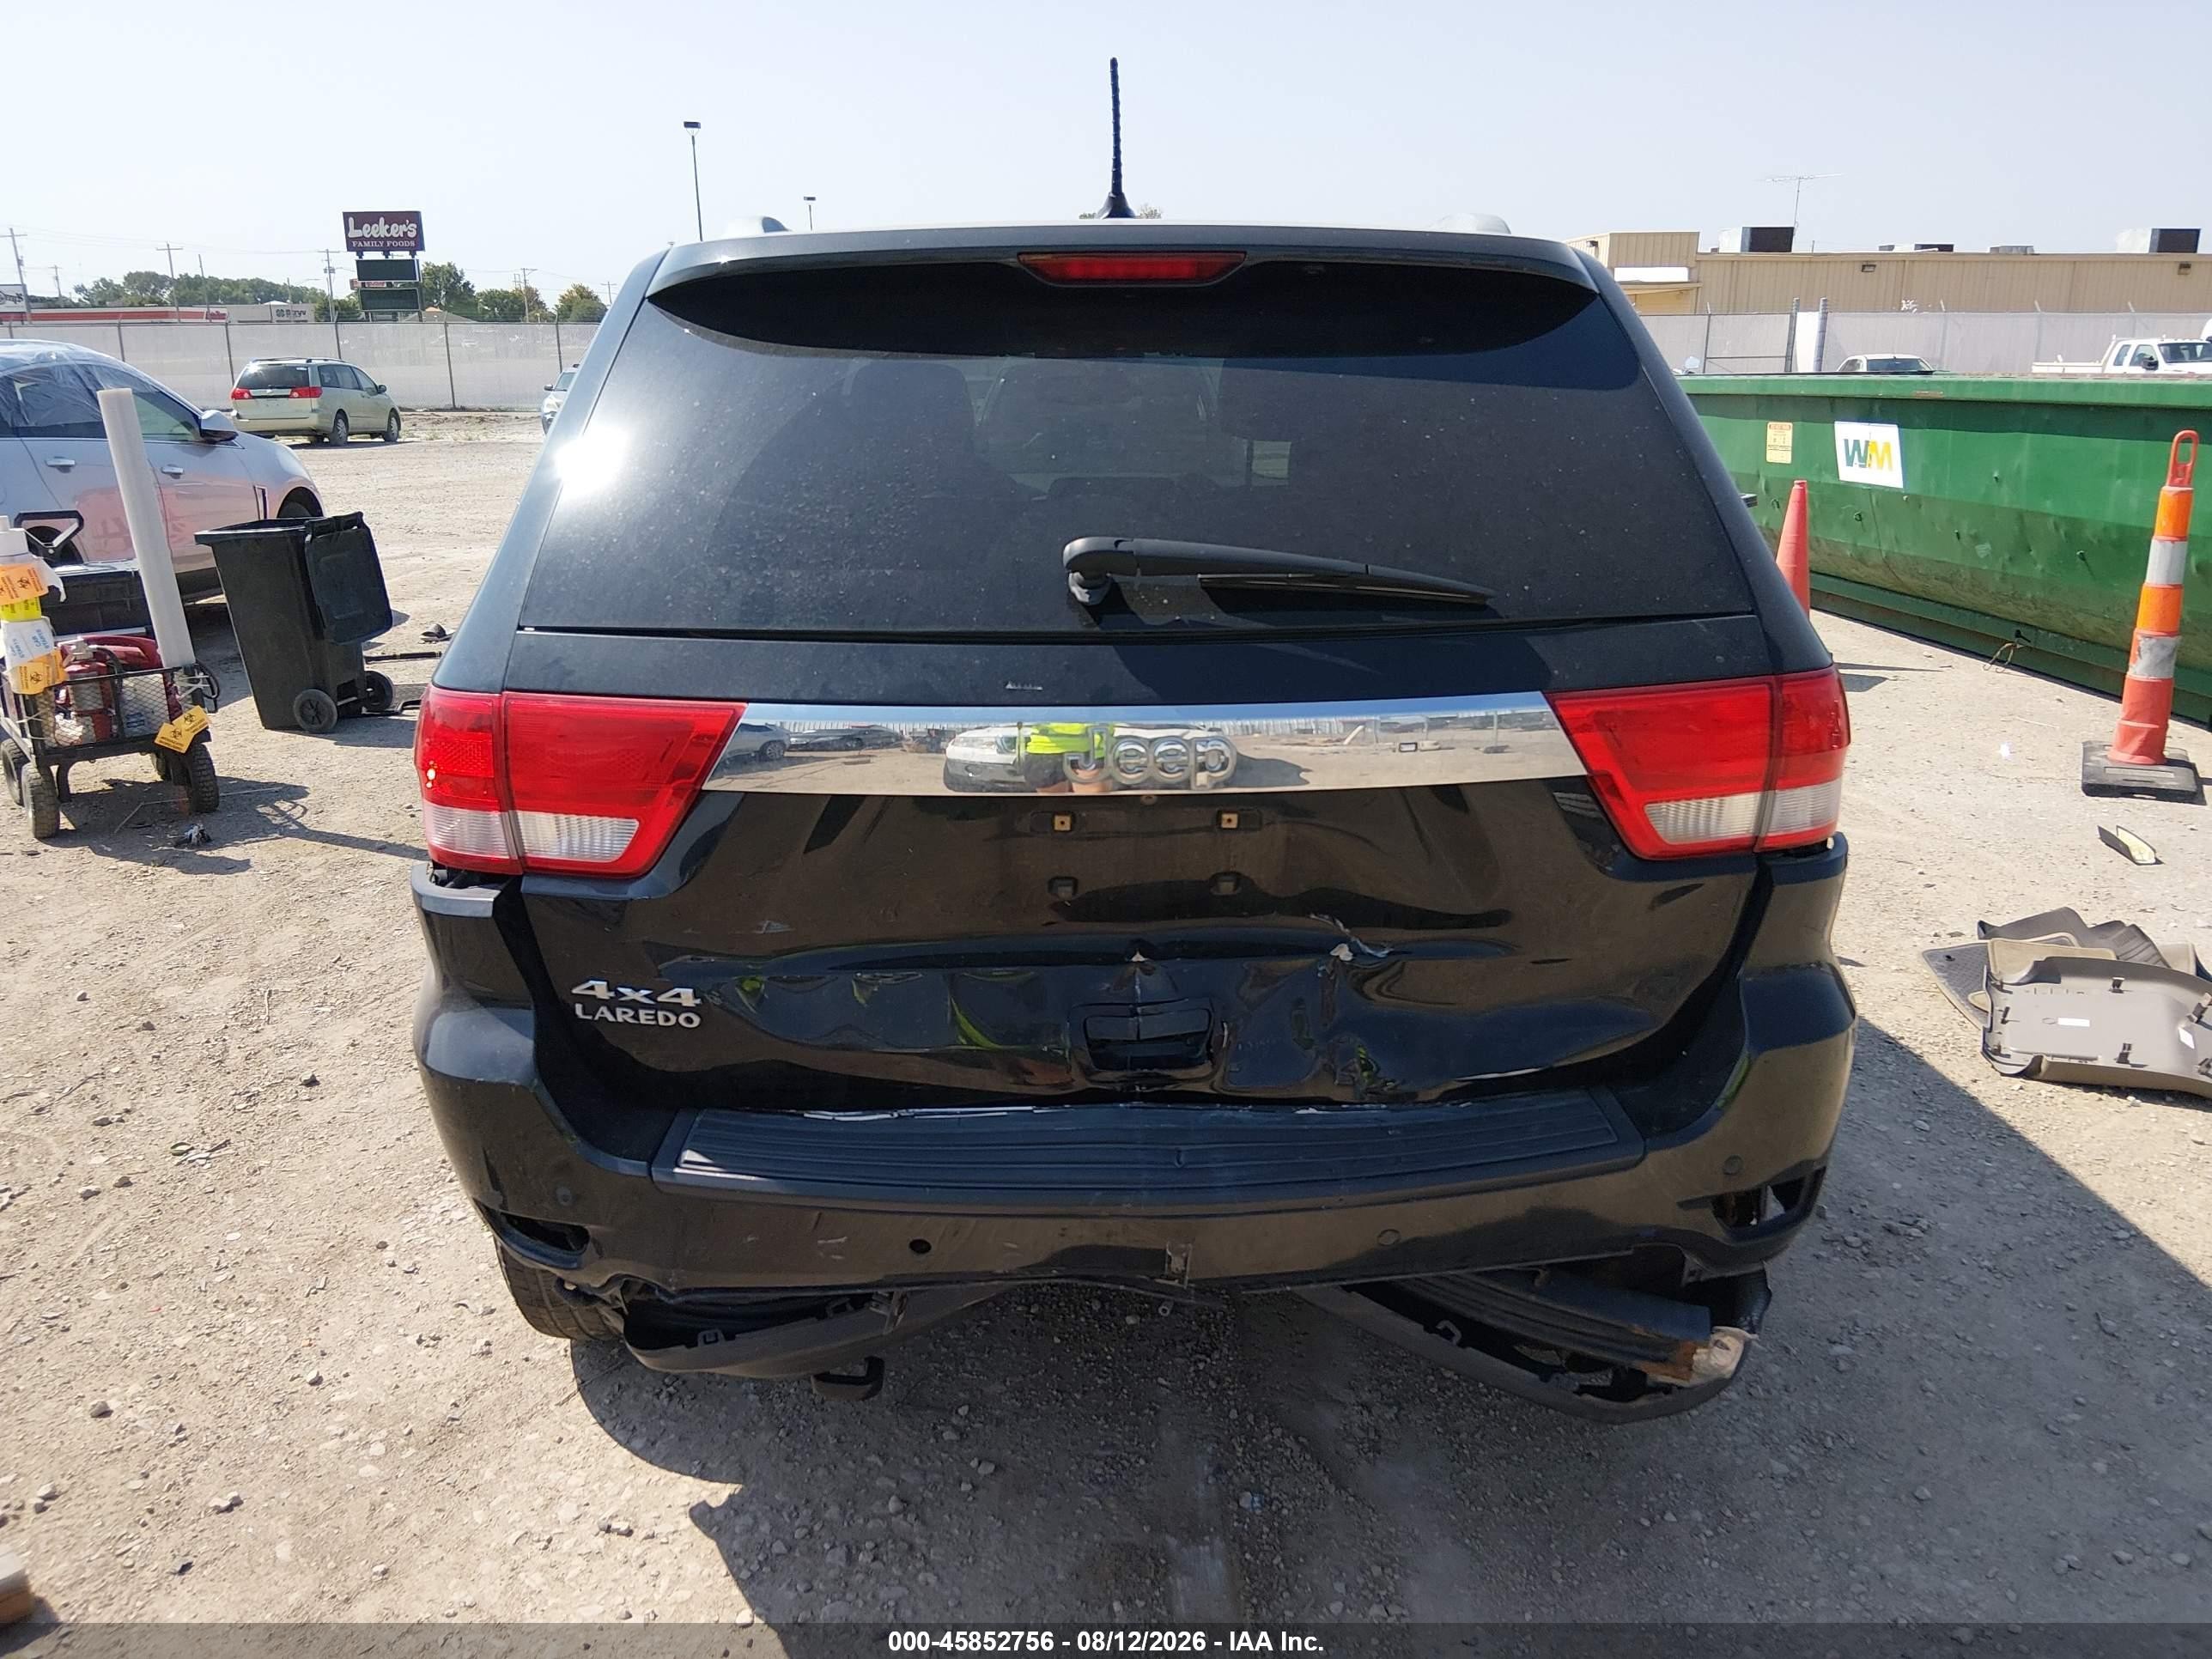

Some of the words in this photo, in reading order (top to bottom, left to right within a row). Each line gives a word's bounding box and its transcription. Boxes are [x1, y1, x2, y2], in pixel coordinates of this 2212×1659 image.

[348, 216, 417, 238] Leeker's
[1844, 438, 1893, 471] WM
[1063, 726, 1237, 790] Jeep
[571, 980, 702, 1006] 4x4
[574, 1003, 701, 1029] LAREDO
